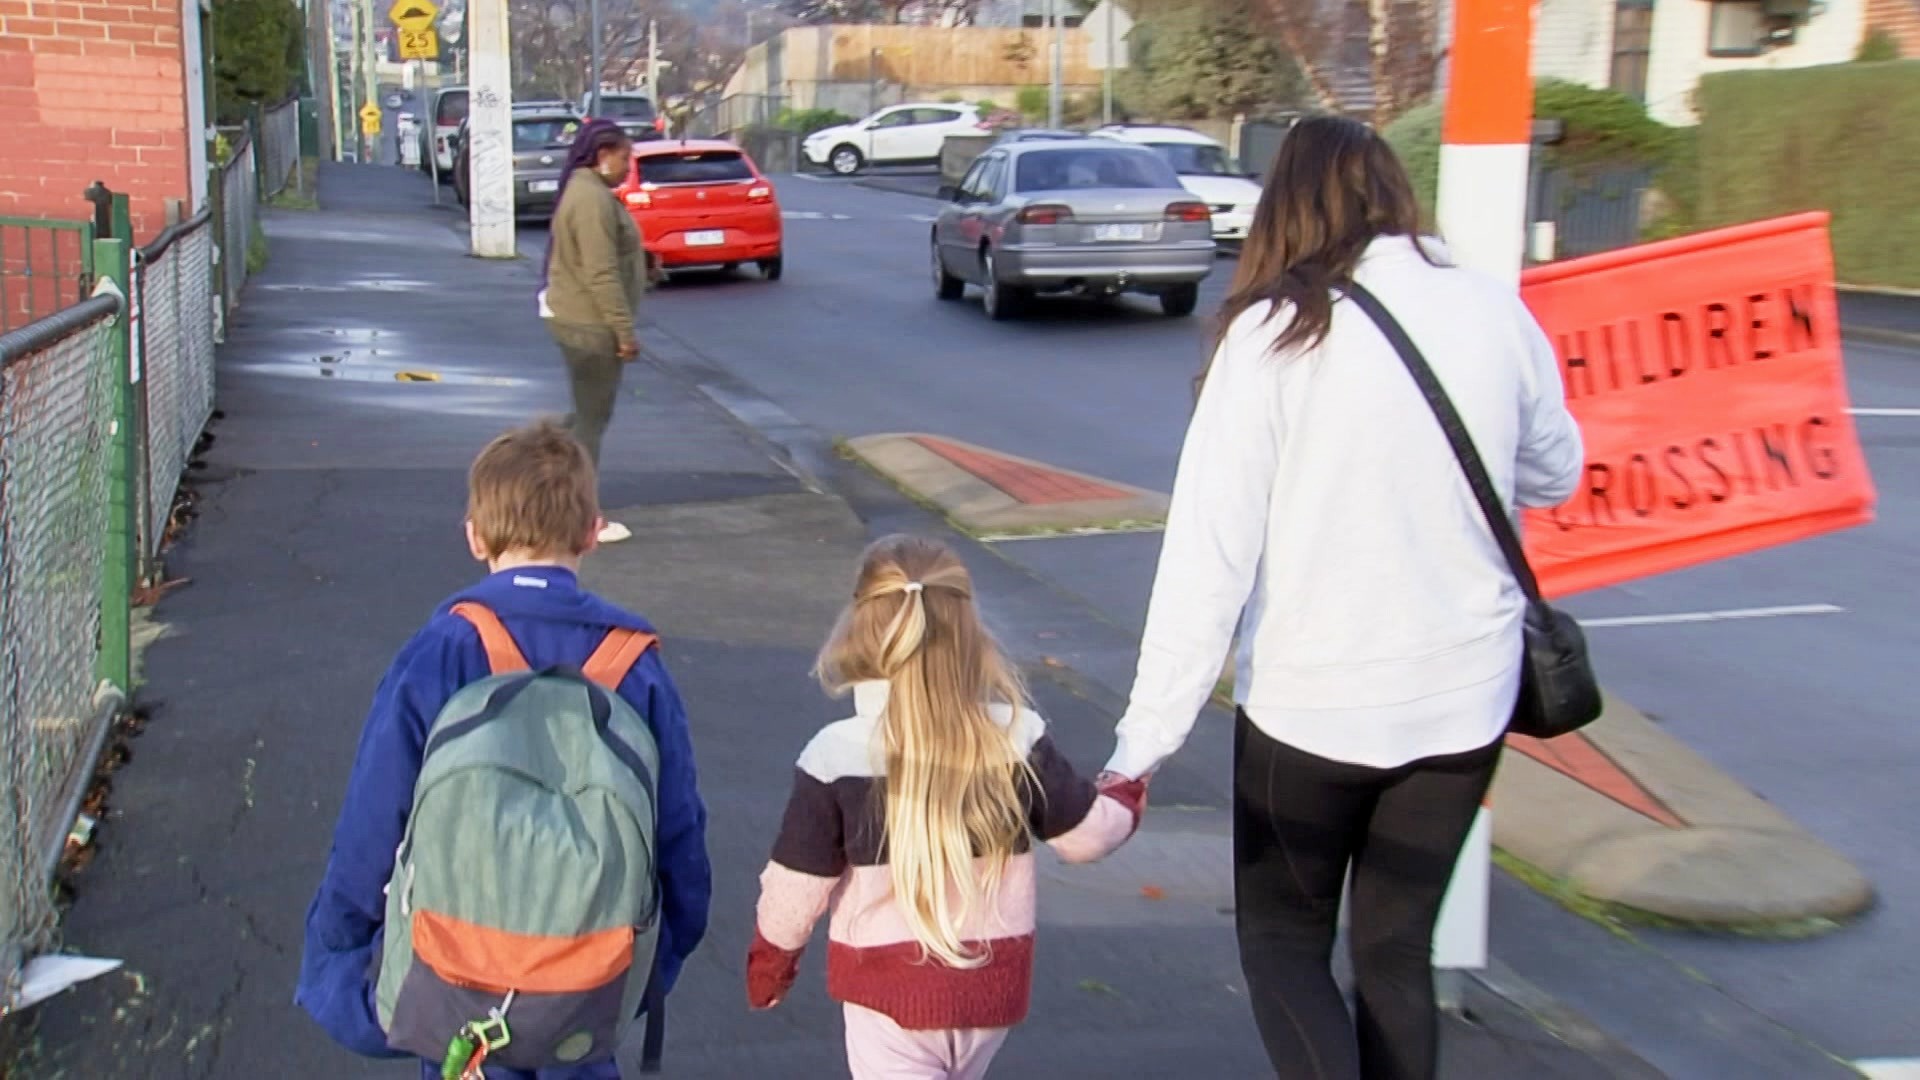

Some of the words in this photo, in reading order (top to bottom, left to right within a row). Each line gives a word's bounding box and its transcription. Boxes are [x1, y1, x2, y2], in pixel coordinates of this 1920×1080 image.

[405, 32, 429, 48] 25
[1556, 284, 1818, 400] HILDREN
[1550, 416, 1837, 531] ROSSING
